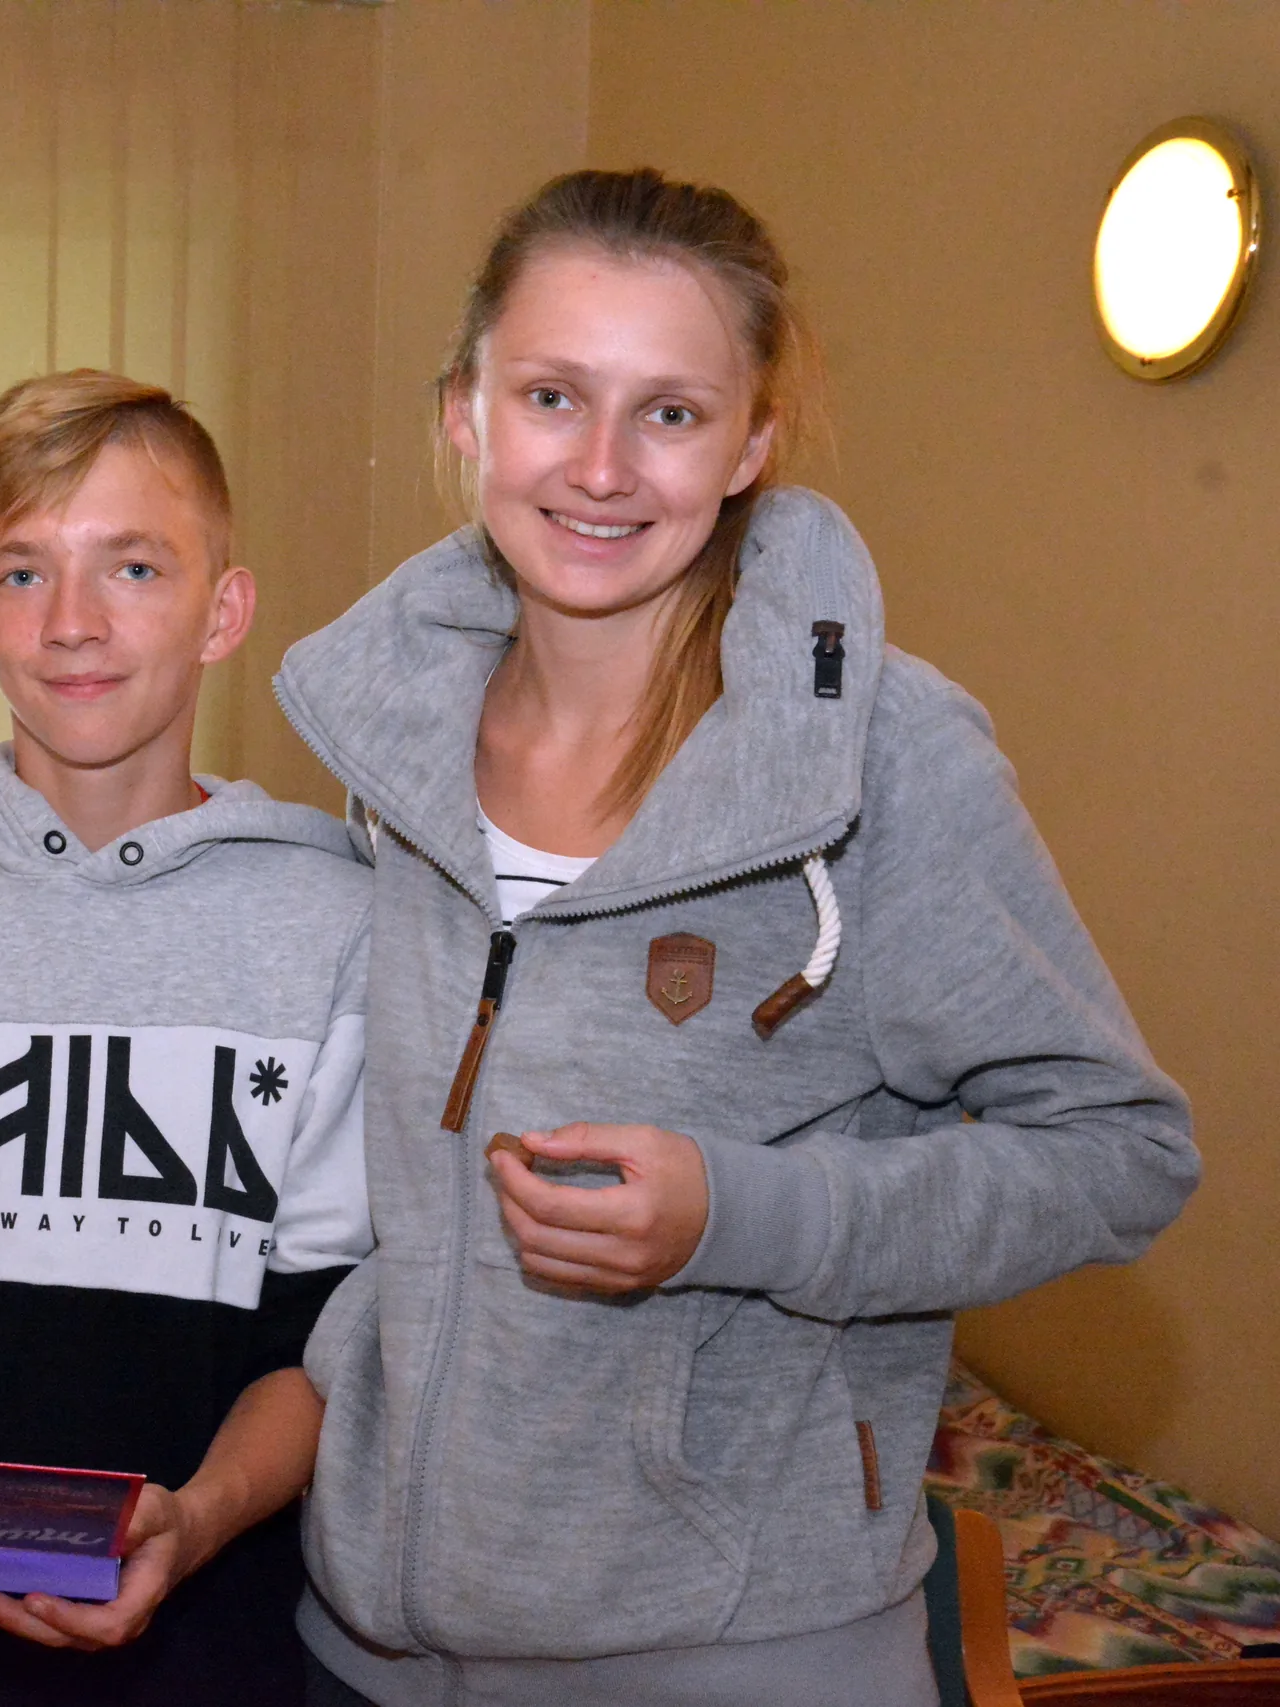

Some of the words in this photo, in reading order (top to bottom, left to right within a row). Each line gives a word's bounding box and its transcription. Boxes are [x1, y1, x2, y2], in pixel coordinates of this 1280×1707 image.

[0, 1212, 85, 1232] WAY
[117, 1217, 162, 1237] TO
[191, 1223, 270, 1256] LVE
